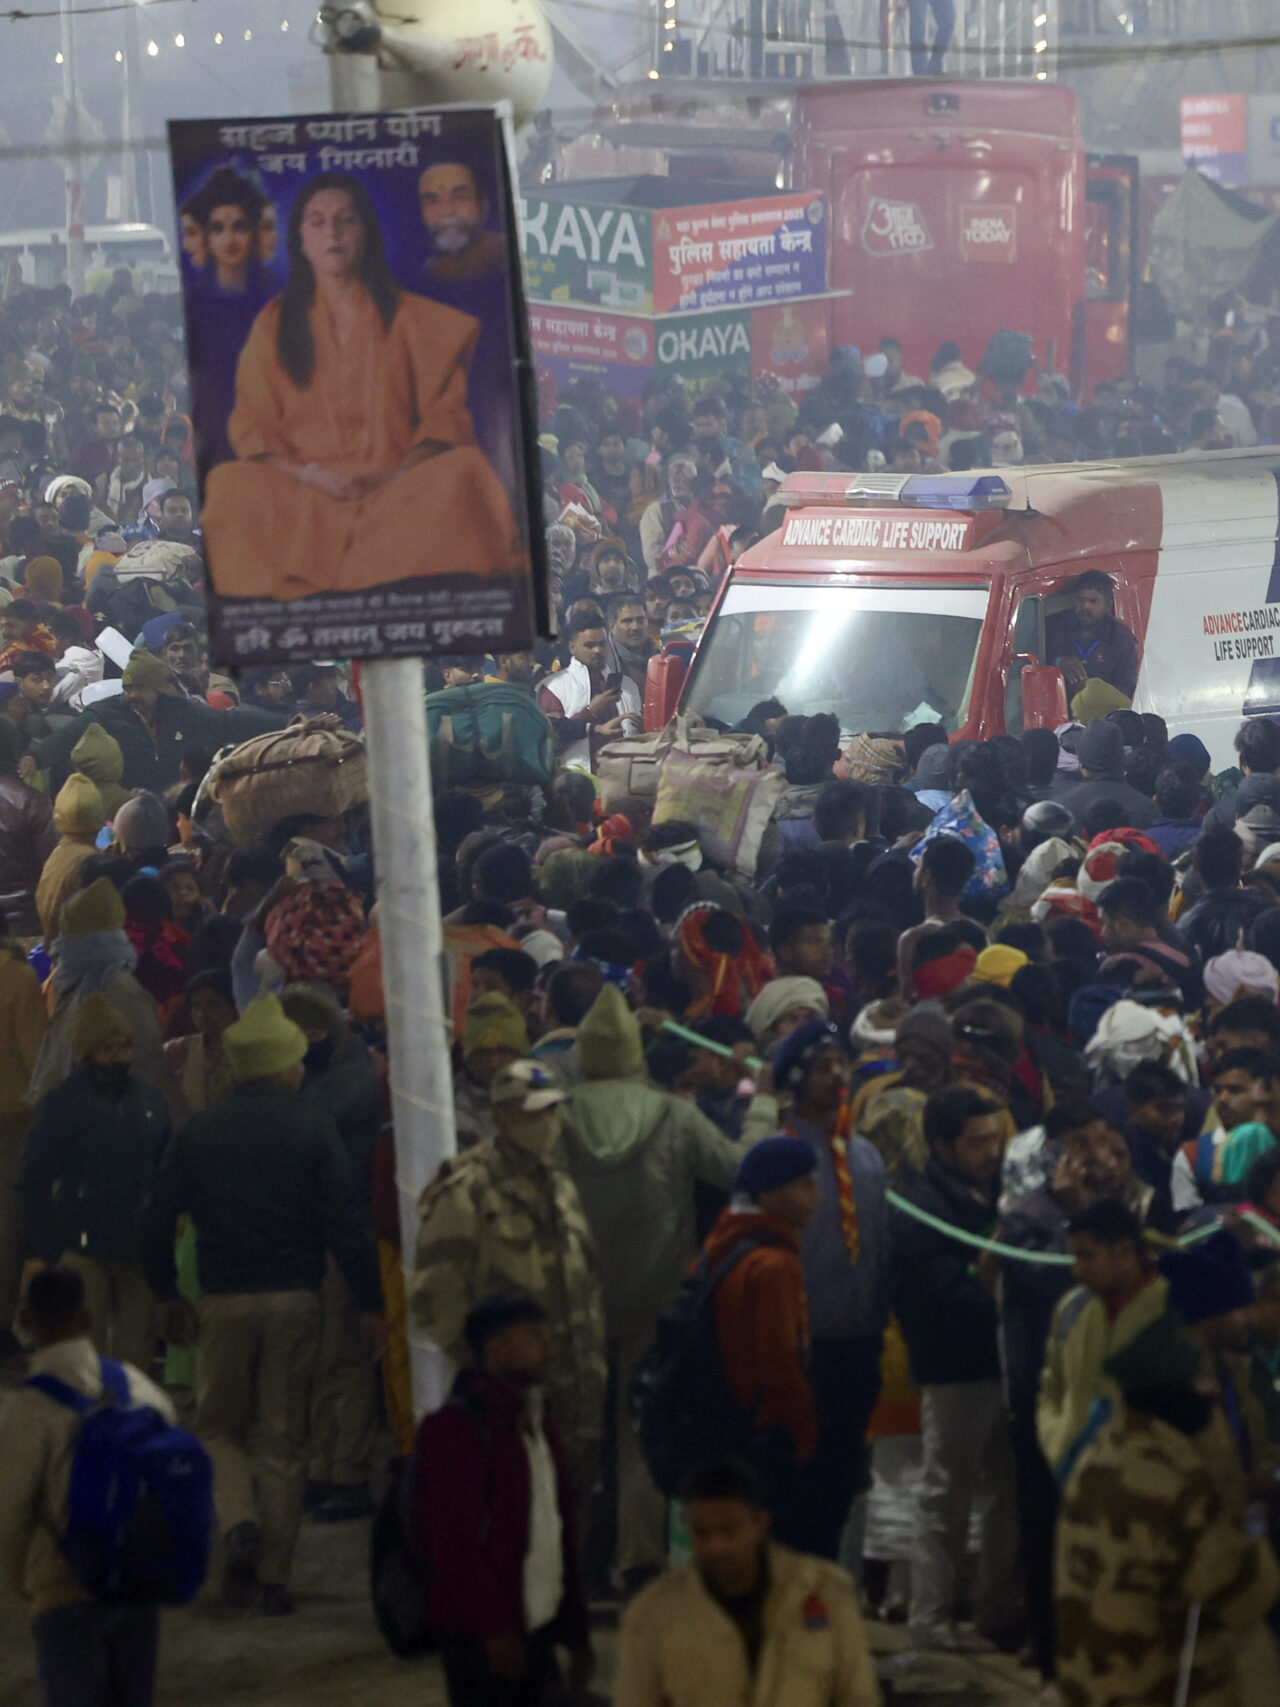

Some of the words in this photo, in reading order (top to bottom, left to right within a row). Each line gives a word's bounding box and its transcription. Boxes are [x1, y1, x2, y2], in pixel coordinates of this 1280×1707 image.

[519, 197, 646, 268] KAYA
[965, 229, 1012, 243] TODAY
[970, 218, 1006, 230] INDIA
[668, 234, 714, 276] पुलिस
[717, 234, 776, 262] सहायता
[779, 223, 813, 253] केन्द्र
[657, 323, 751, 364] OKAYA
[783, 518, 833, 547] ADVANCE
[832, 518, 881, 548] CARDIAC
[882, 521, 910, 549] LIFE
[909, 522, 968, 551] SUPPORT
[1213, 640, 1235, 662] LIFE
[1234, 635, 1275, 659] SUPPORT
